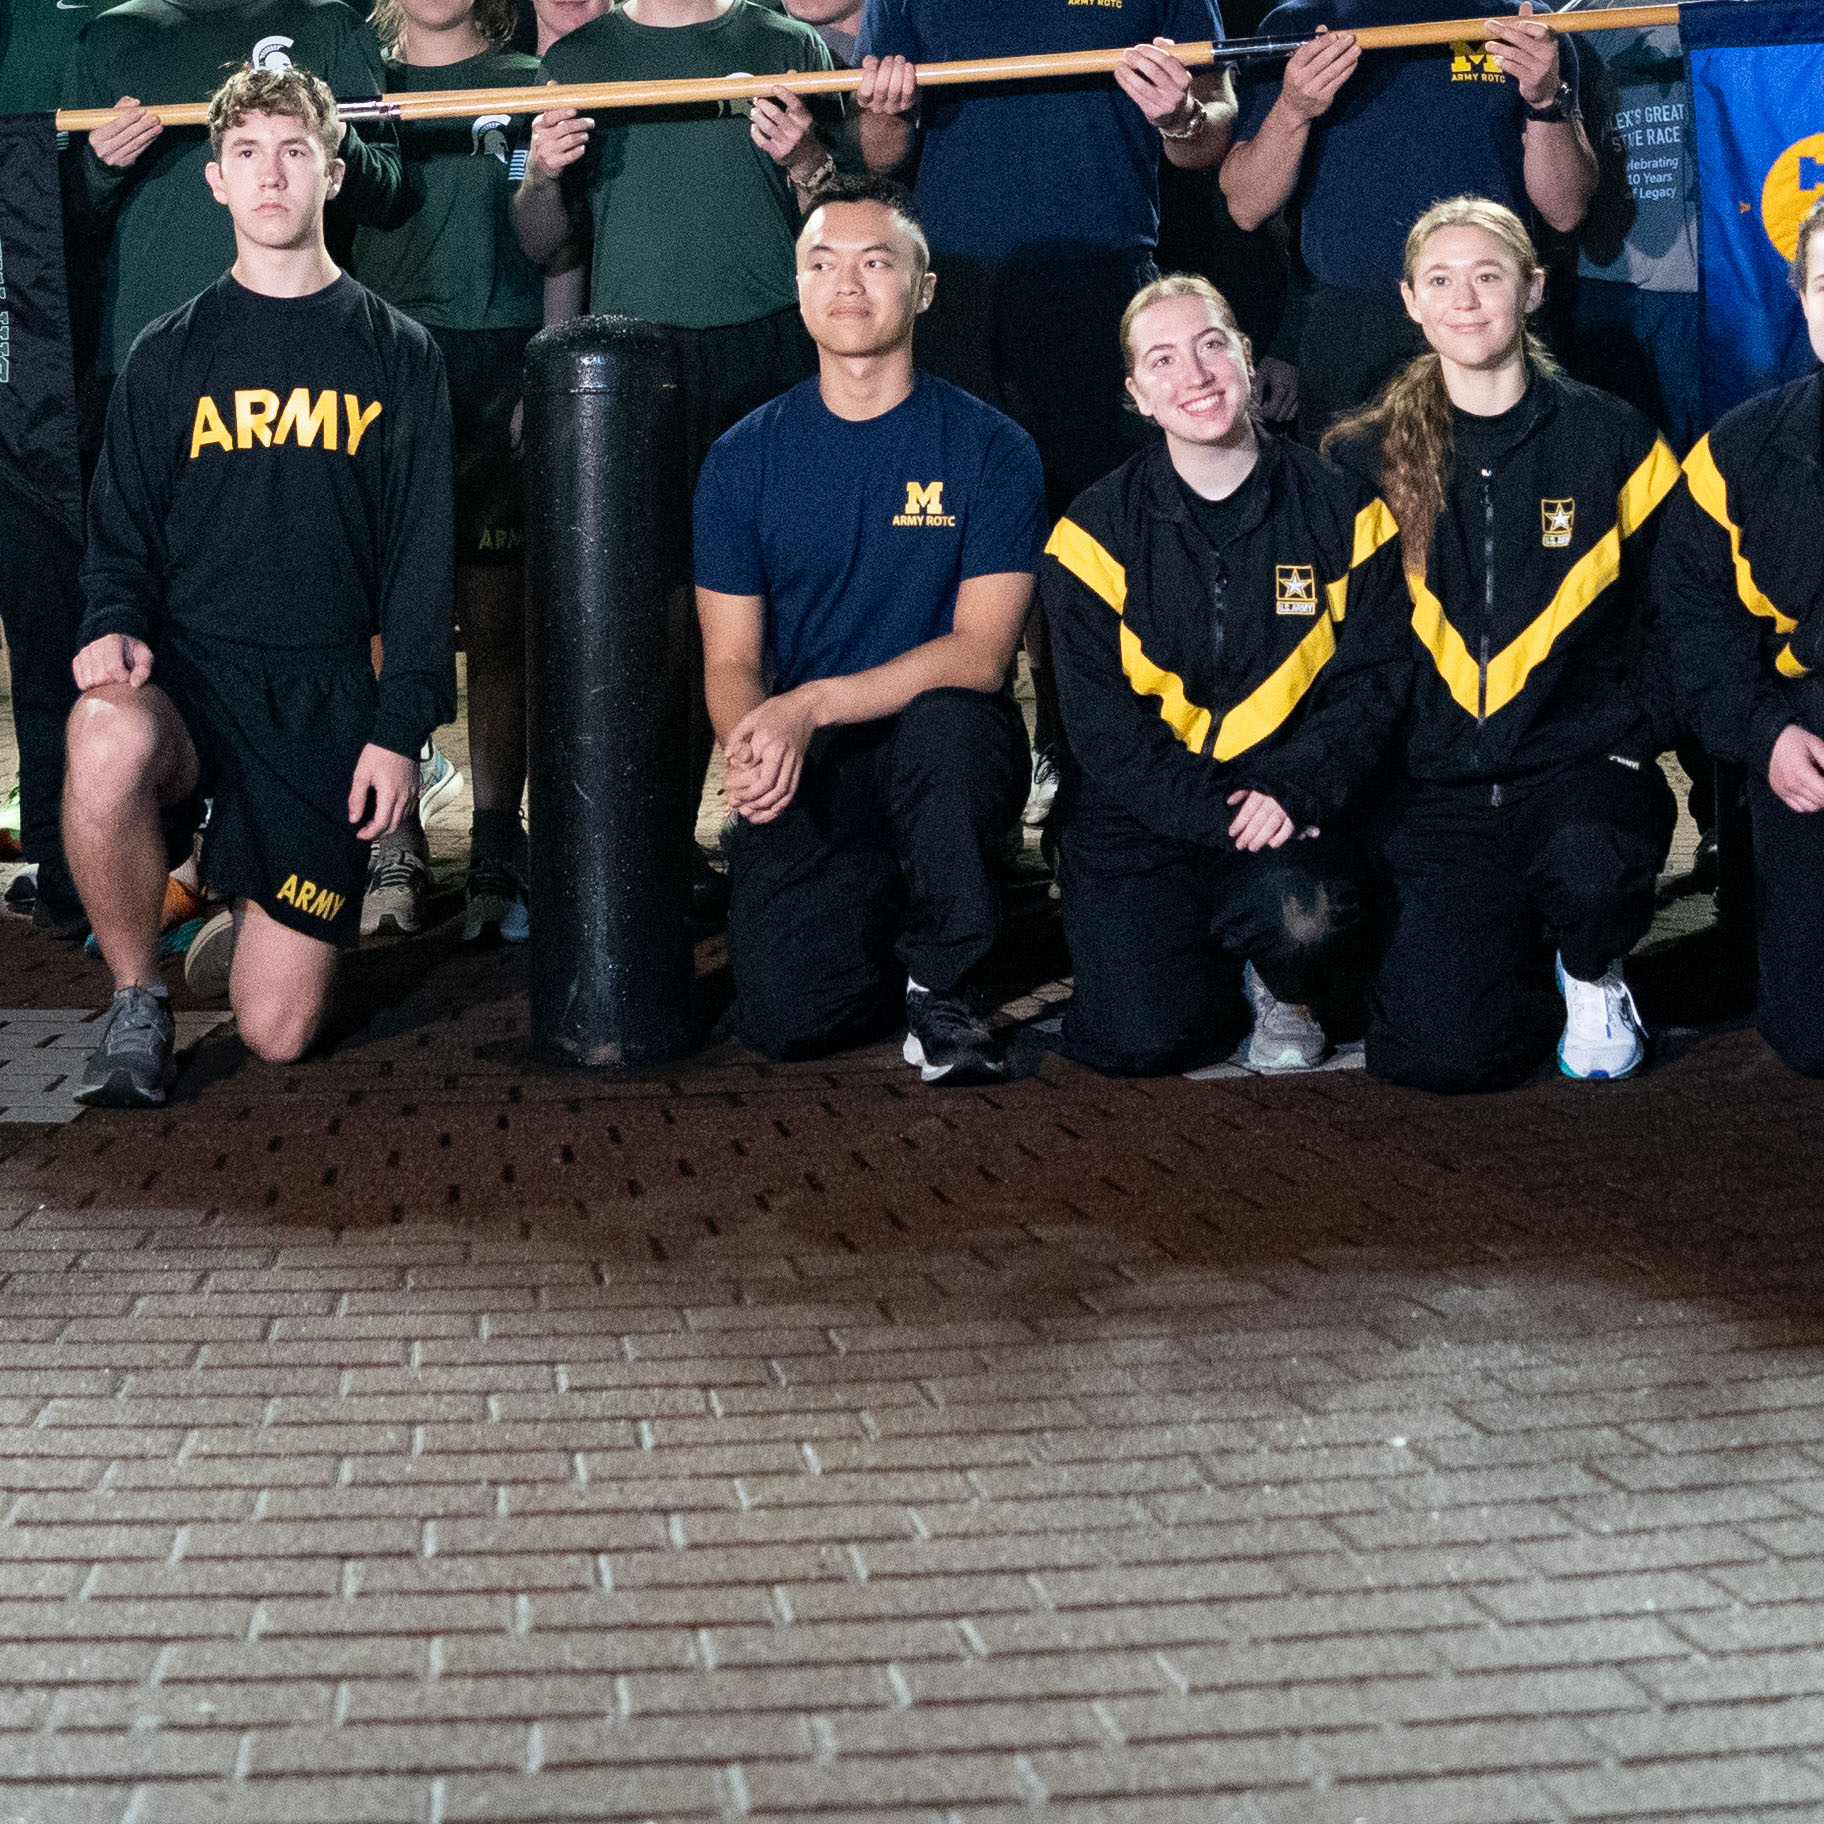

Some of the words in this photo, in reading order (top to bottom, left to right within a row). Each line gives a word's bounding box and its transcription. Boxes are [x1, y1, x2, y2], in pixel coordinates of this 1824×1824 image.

[1451, 73, 1478, 83] ARMY
[1480, 73, 1507, 84] ROTC
[1645, 104, 1684, 123] GREAT
[1646, 126, 1681, 146] RACE
[1643, 173, 1673, 184] Years
[1639, 186, 1677, 201] Legacy
[189, 387, 383, 460] ARMY
[904, 481, 944, 514] M
[892, 515, 925, 527] ARMY
[925, 515, 956, 527] ROTC
[275, 872, 347, 923] ARMY
